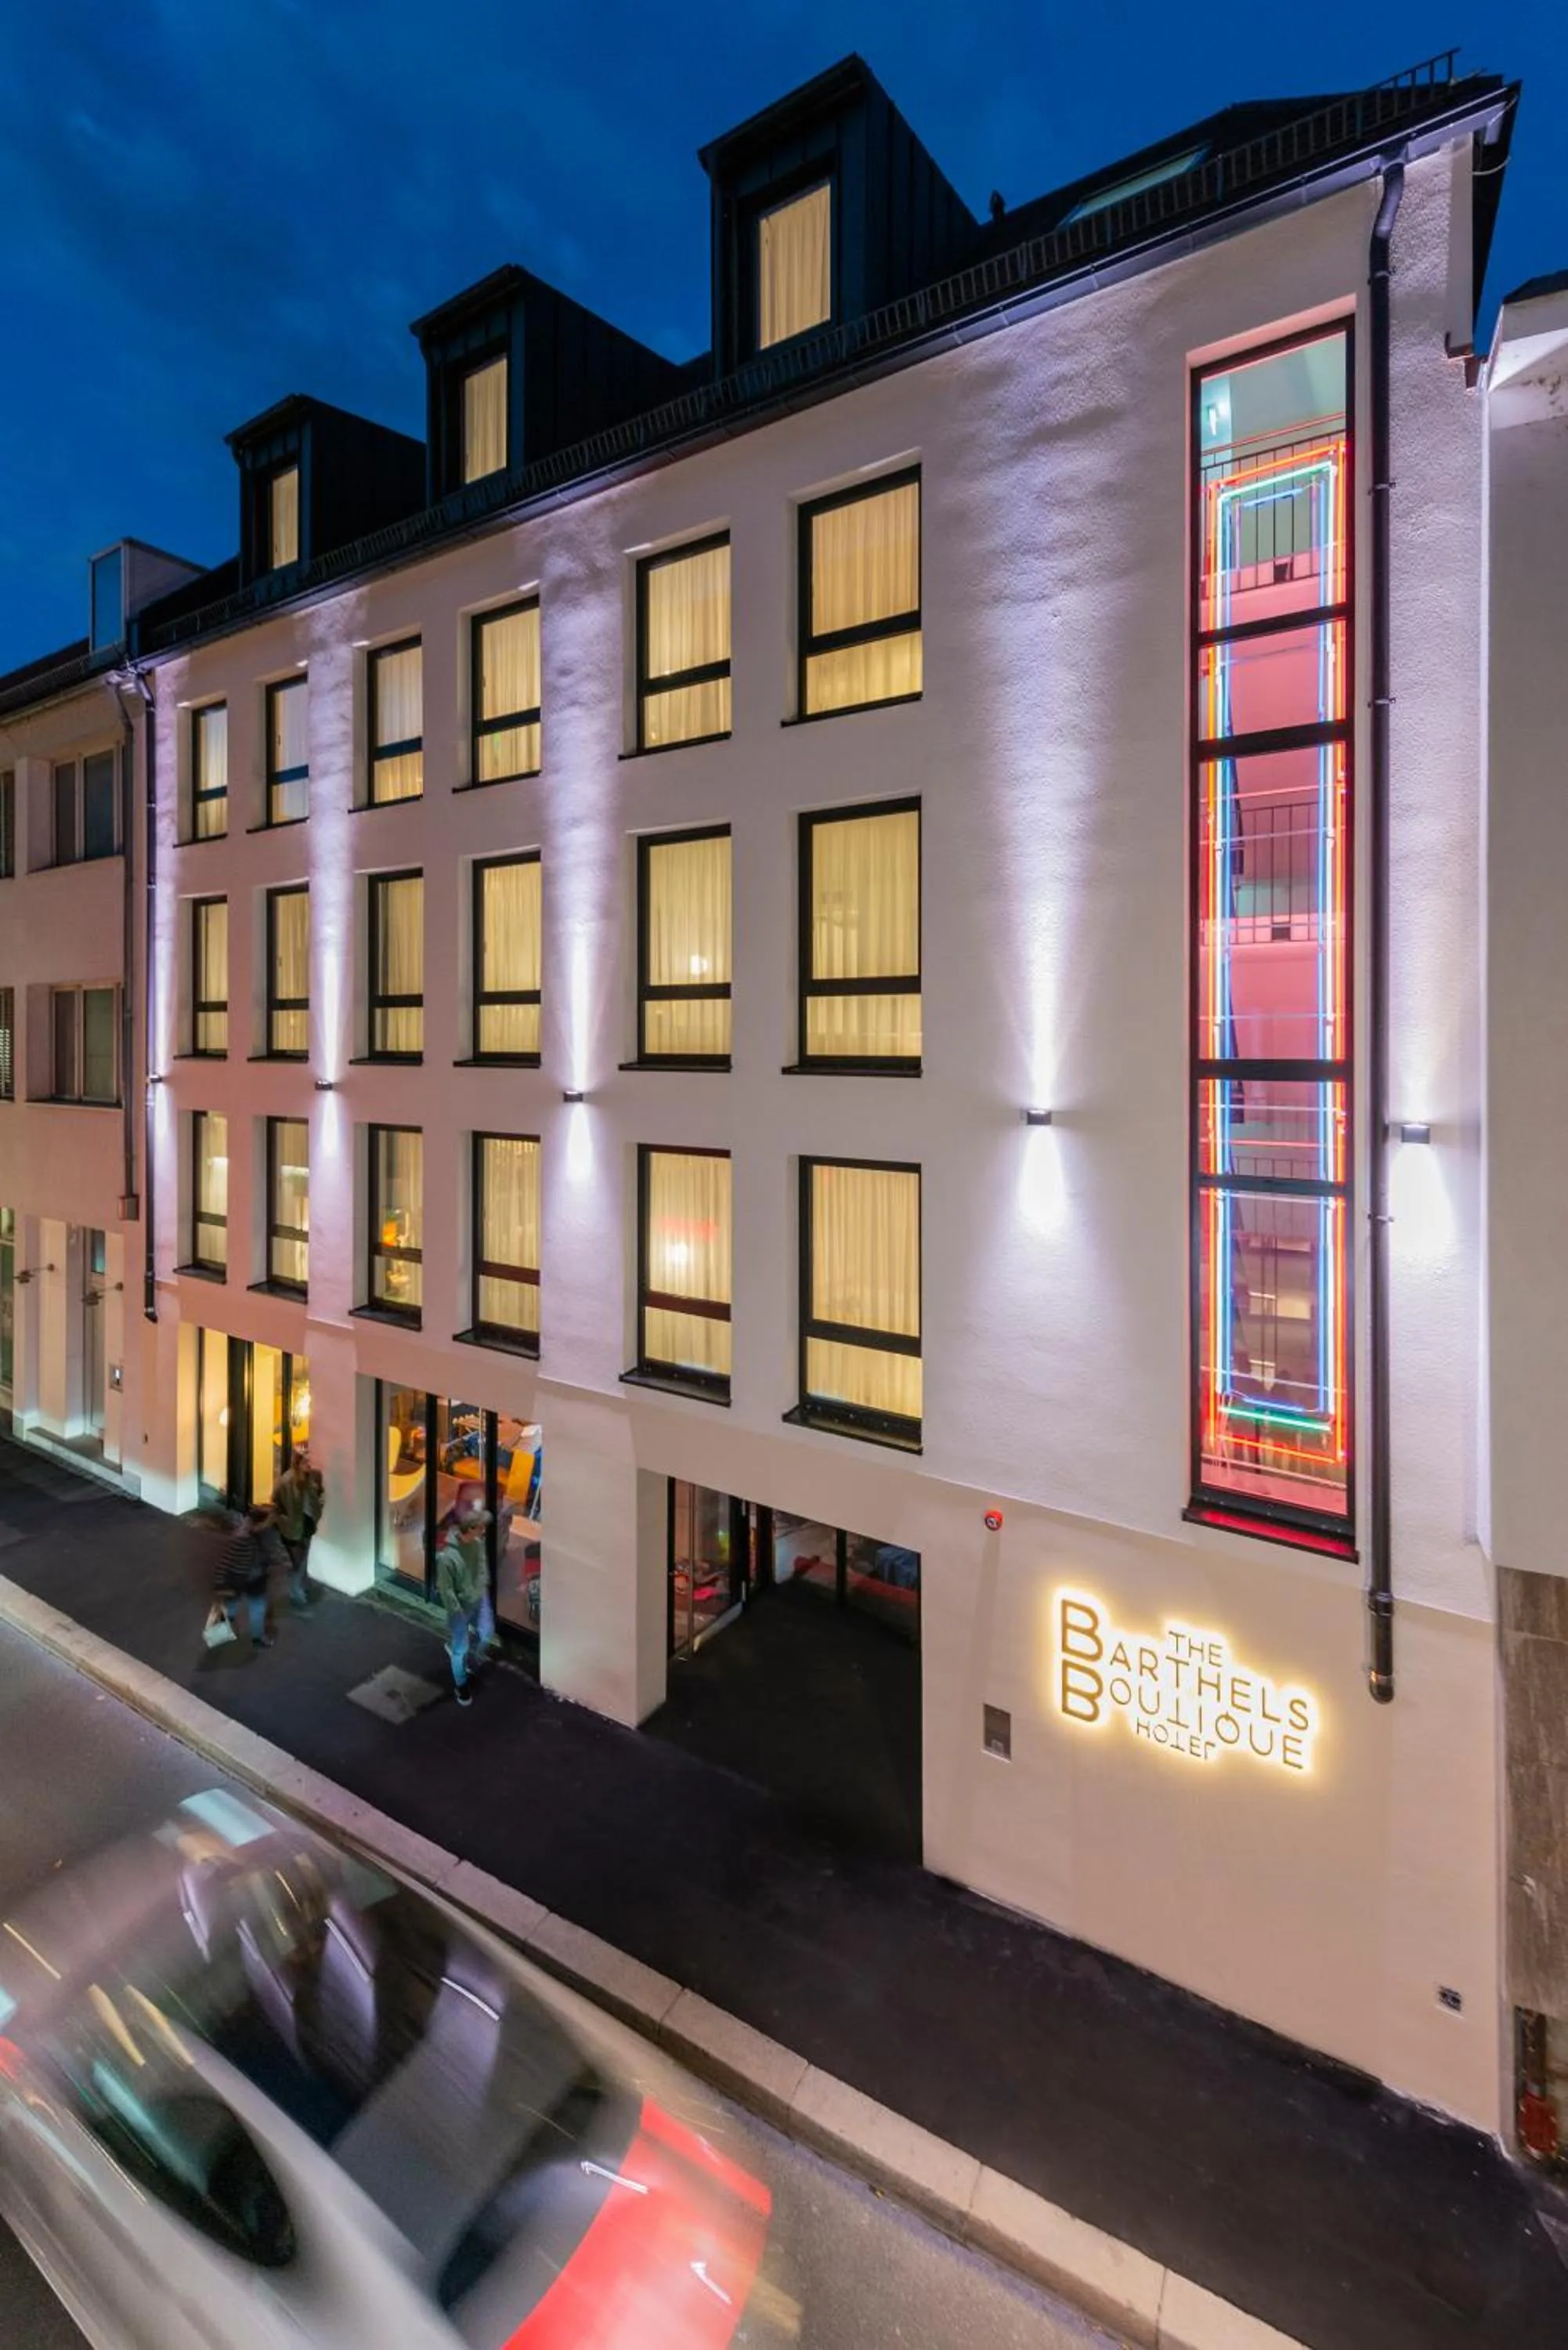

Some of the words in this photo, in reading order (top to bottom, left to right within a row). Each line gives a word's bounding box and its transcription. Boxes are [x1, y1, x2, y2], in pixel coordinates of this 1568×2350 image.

[1060, 1599, 1310, 1731] BARTHELS
[1168, 1630, 1223, 1668] THE
[1060, 1658, 1304, 1770] BOUTIQUE
[1136, 1716, 1216, 1761] HOTEL
